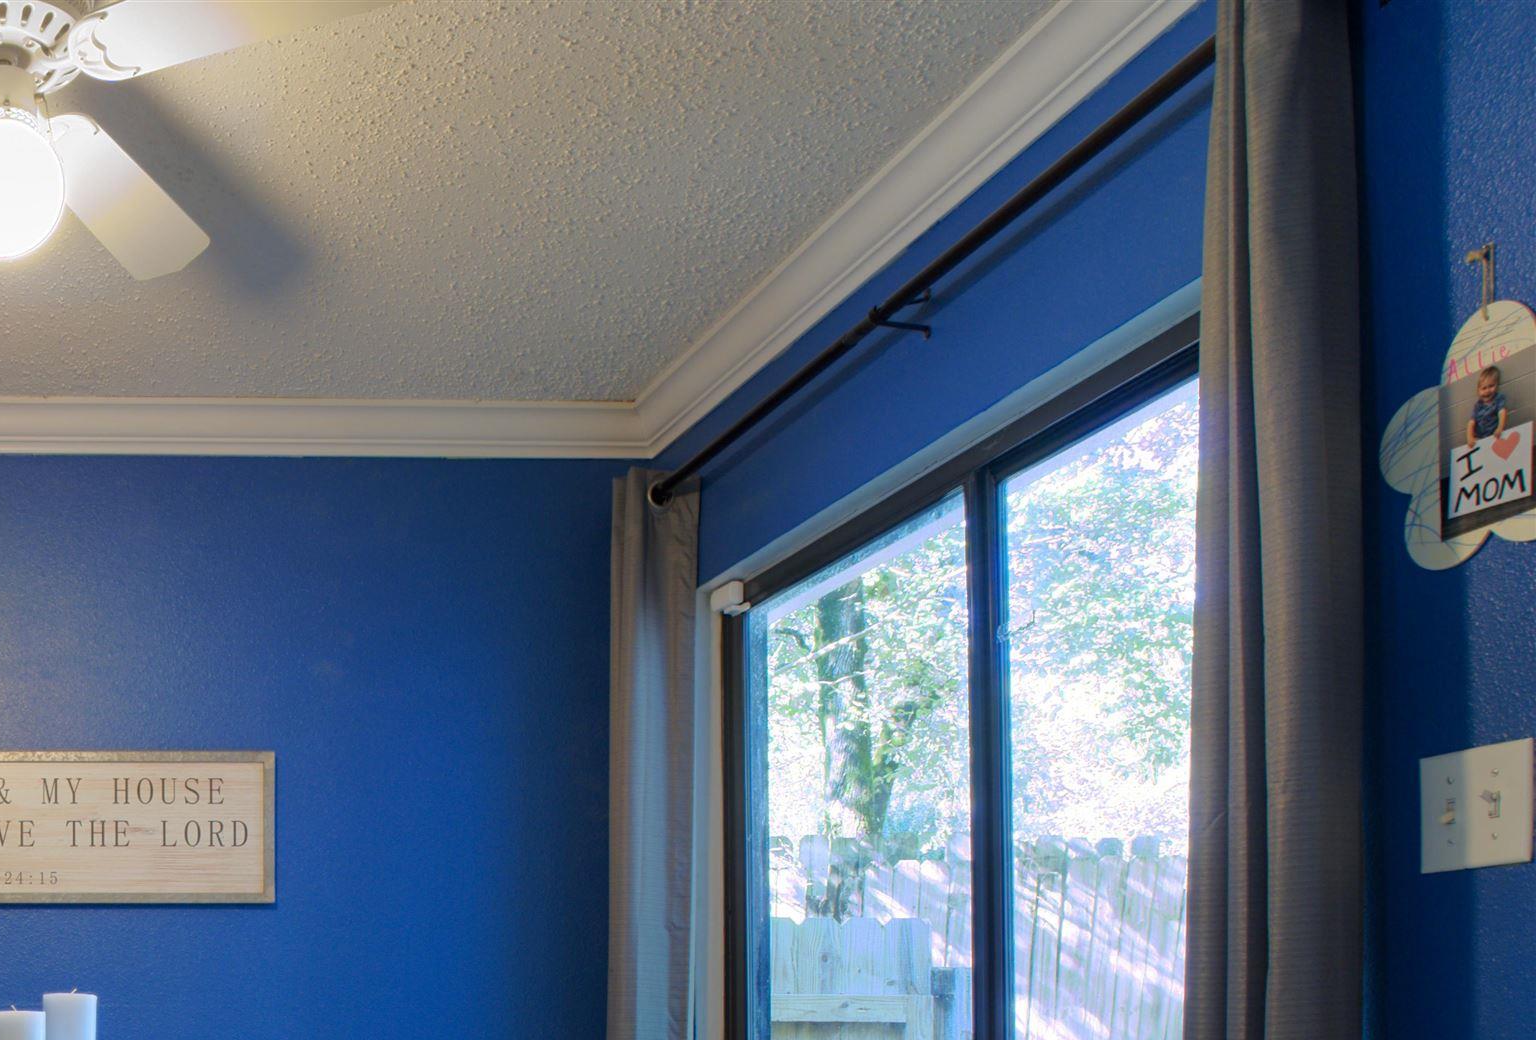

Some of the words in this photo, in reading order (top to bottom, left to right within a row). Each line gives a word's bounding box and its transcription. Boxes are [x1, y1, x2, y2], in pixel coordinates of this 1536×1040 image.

[1456, 446, 1483, 481] I
[1454, 468, 1526, 513] MOM
[41, 777, 83, 805] MY
[112, 777, 225, 806] HOUSE
[66, 820, 131, 848] THE
[160, 820, 249, 848] LORD
[4, 871, 59, 886] 24:15
